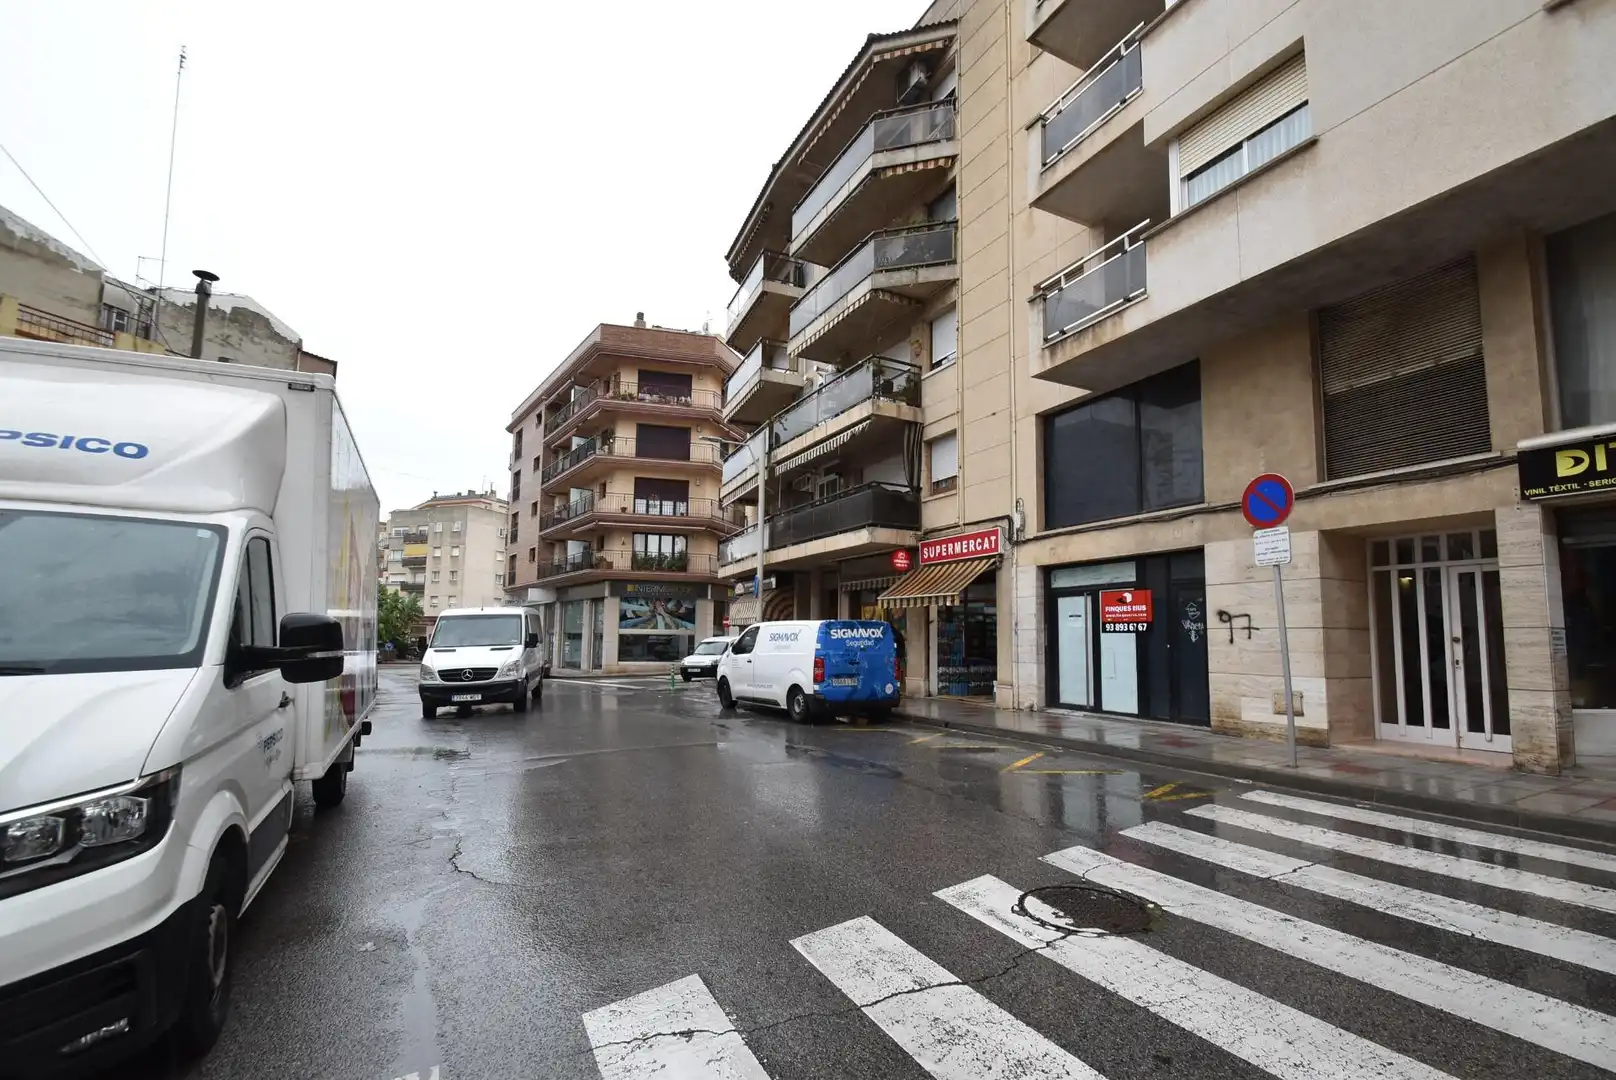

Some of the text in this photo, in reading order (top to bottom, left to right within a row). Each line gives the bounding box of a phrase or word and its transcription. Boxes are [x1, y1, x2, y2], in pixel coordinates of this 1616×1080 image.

[1524, 488, 1547, 496] VINIL
[923, 535, 997, 559] SUPERMERCAT
[1105, 604, 1132, 613] FINQUES
[1105, 623, 1114, 632] 93
[1115, 623, 1128, 632] 893
[1138, 623, 1148, 632] 67
[830, 626, 884, 639] SIGMAVOX
